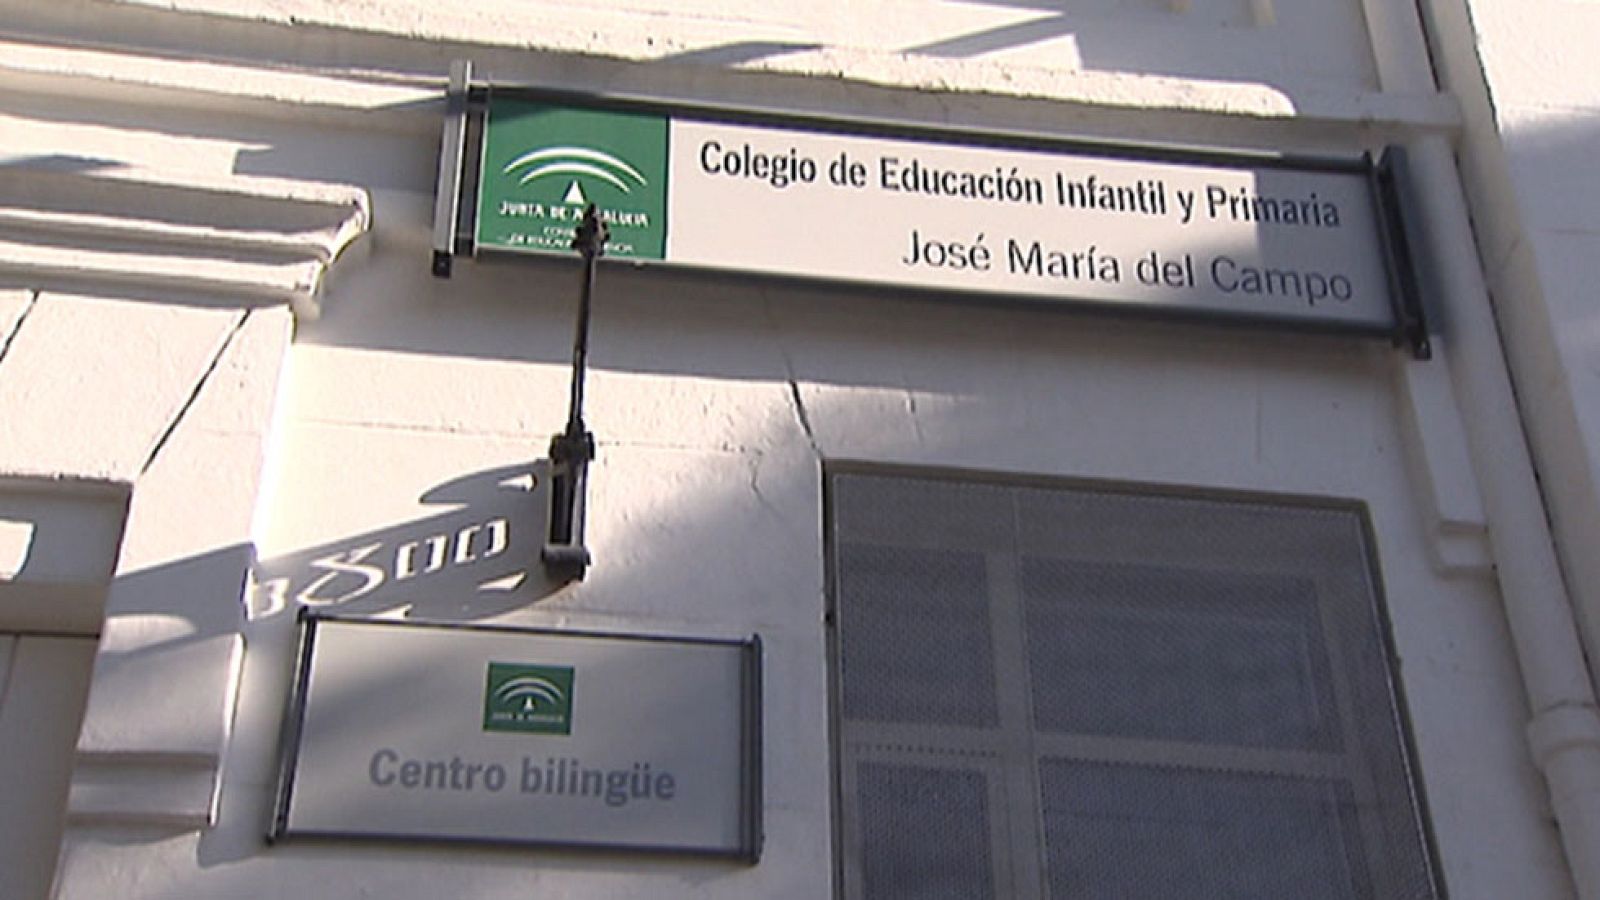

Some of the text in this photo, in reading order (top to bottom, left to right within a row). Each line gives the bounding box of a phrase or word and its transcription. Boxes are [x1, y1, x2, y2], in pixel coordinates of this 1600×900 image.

[499, 200, 545, 218] JUNTA
[550, 206, 566, 220] DE
[701, 141, 1340, 227] Colegio de Educación Infantil y Primaria
[903, 229, 1354, 306] José María del Campo
[369, 748, 677, 808] Centro bilingüe
